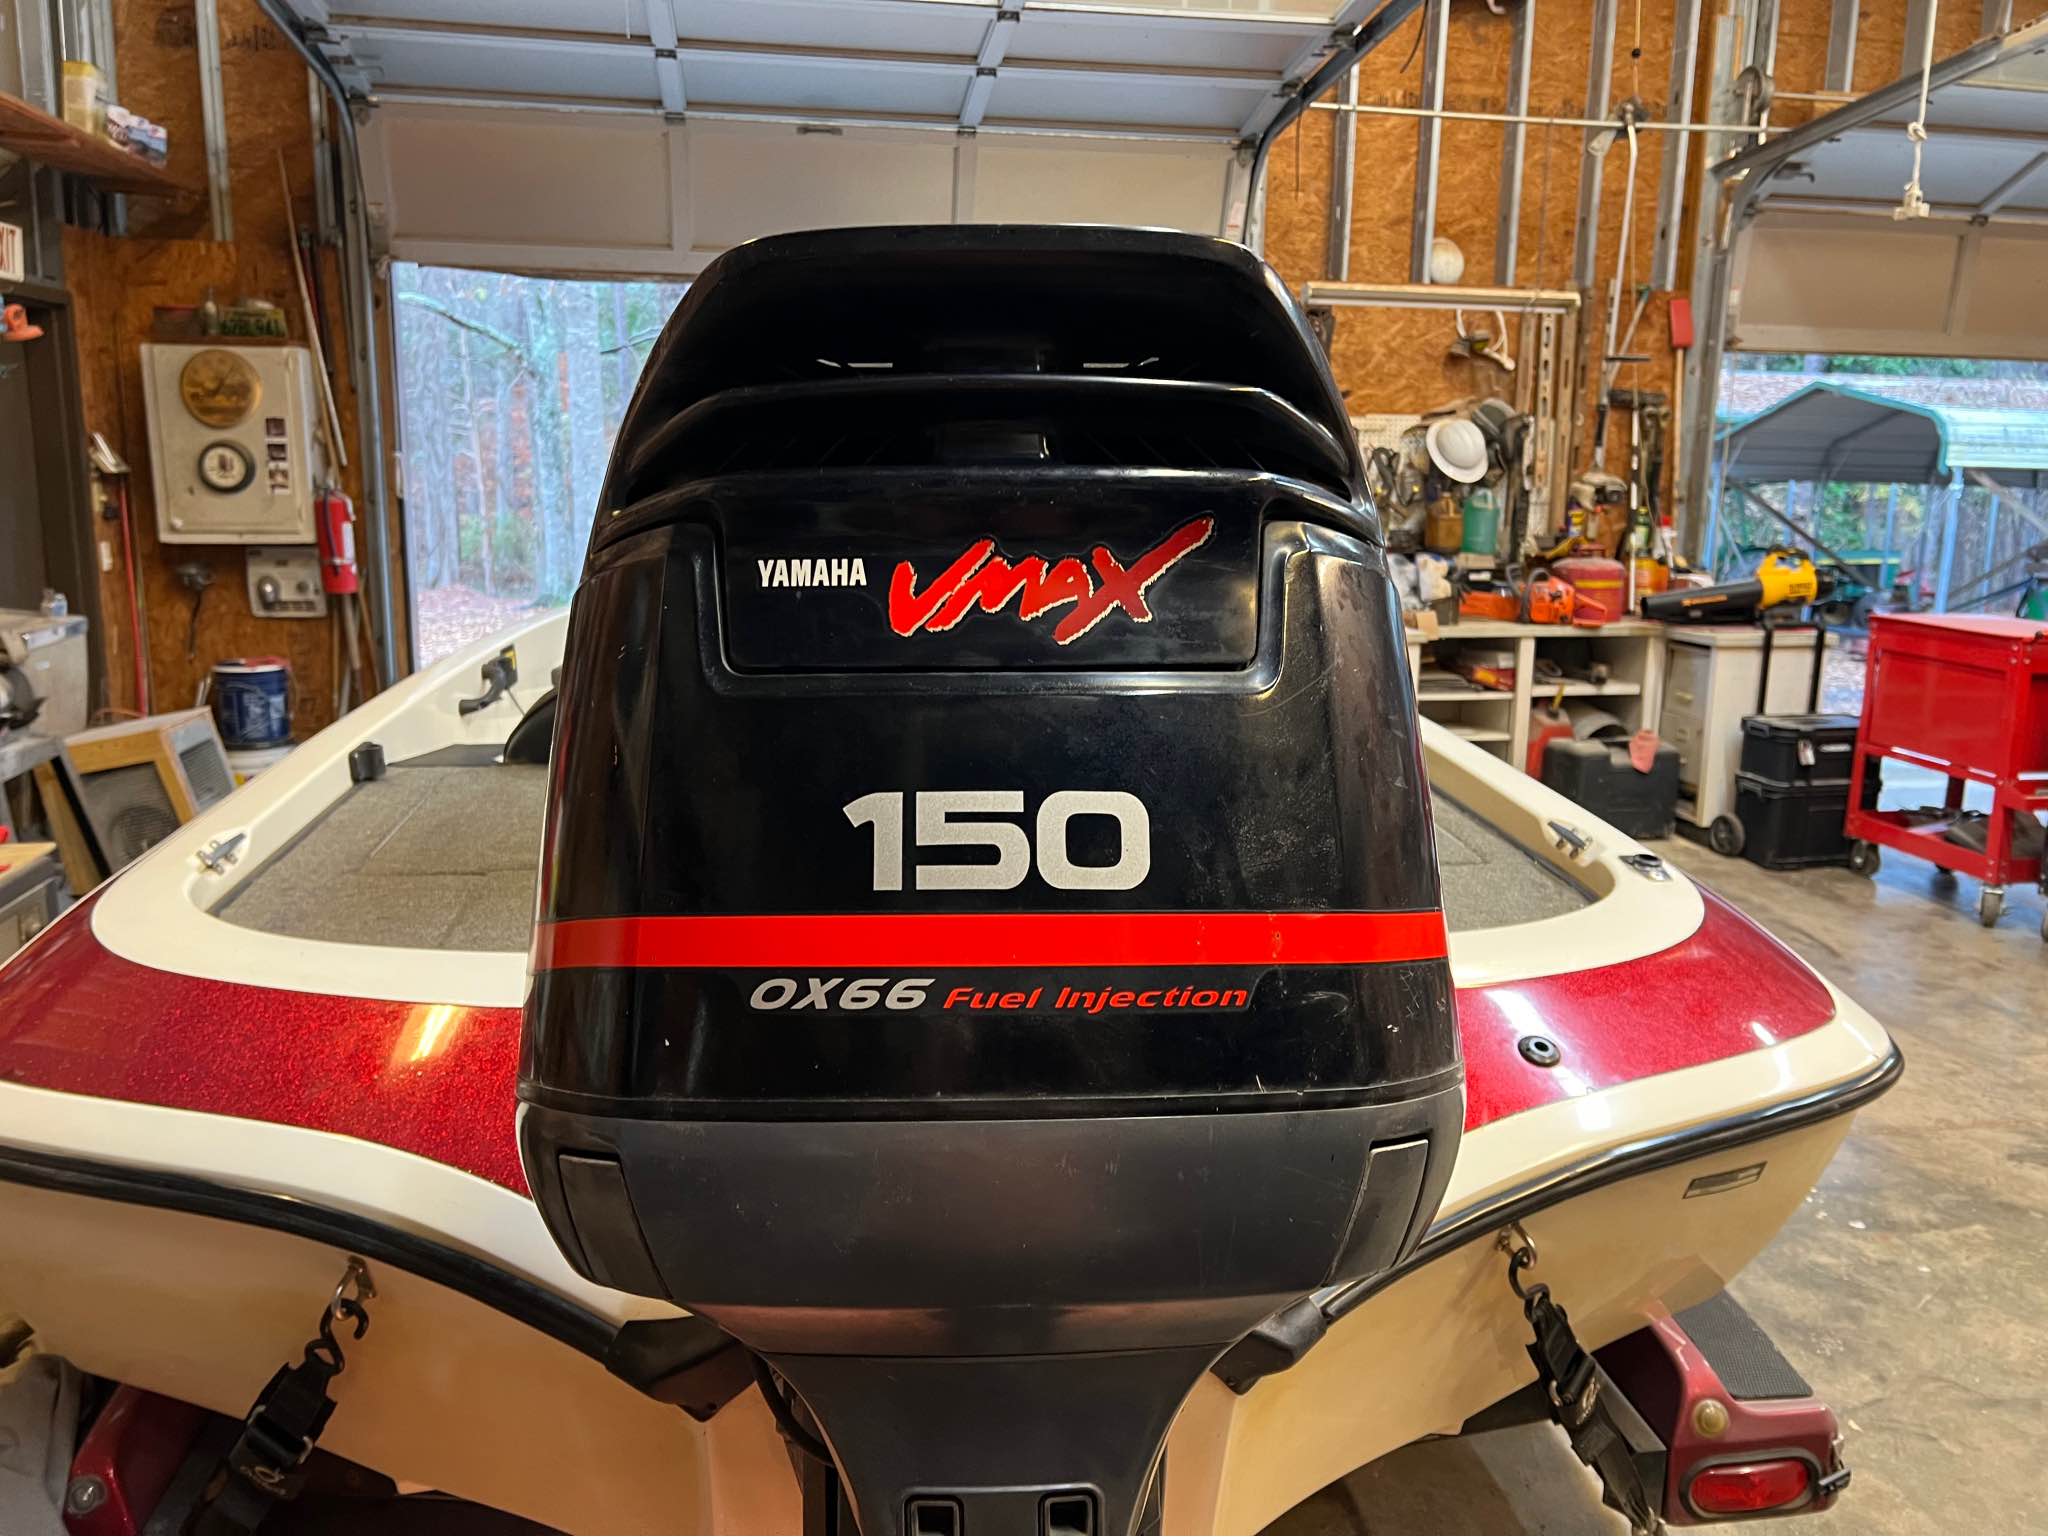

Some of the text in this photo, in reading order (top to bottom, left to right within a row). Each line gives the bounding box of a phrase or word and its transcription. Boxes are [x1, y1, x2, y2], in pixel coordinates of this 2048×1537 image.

[757, 517, 1216, 646] YAMAHA VMAX
[842, 790, 1151, 891] 150
[750, 977, 1249, 1015] OX66 Fuel Injection
